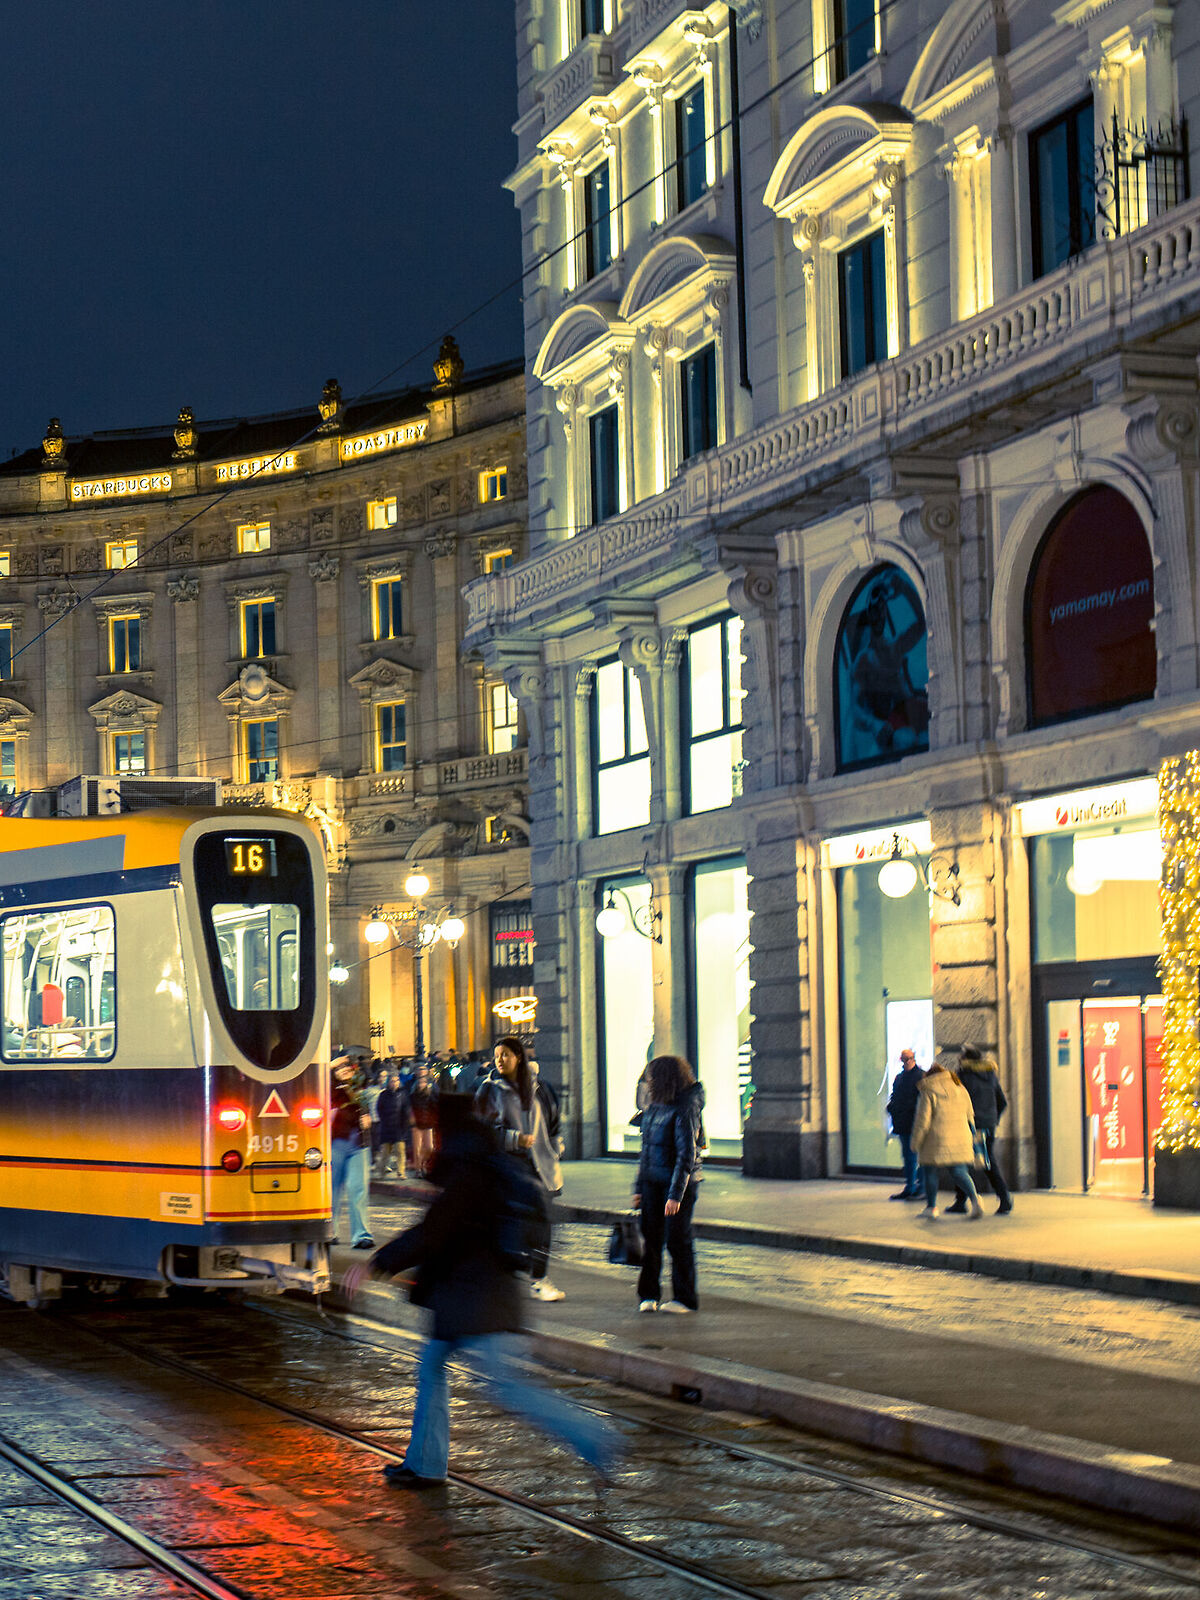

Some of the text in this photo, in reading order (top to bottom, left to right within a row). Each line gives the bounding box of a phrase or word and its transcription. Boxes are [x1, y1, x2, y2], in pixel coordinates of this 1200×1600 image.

[73, 424, 427, 498] STARBUCKS RESERVE ROASTERY
[1049, 578, 1150, 625] yamamay.com
[233, 844, 263, 872] 16
[249, 1134, 299, 1153] 4915
